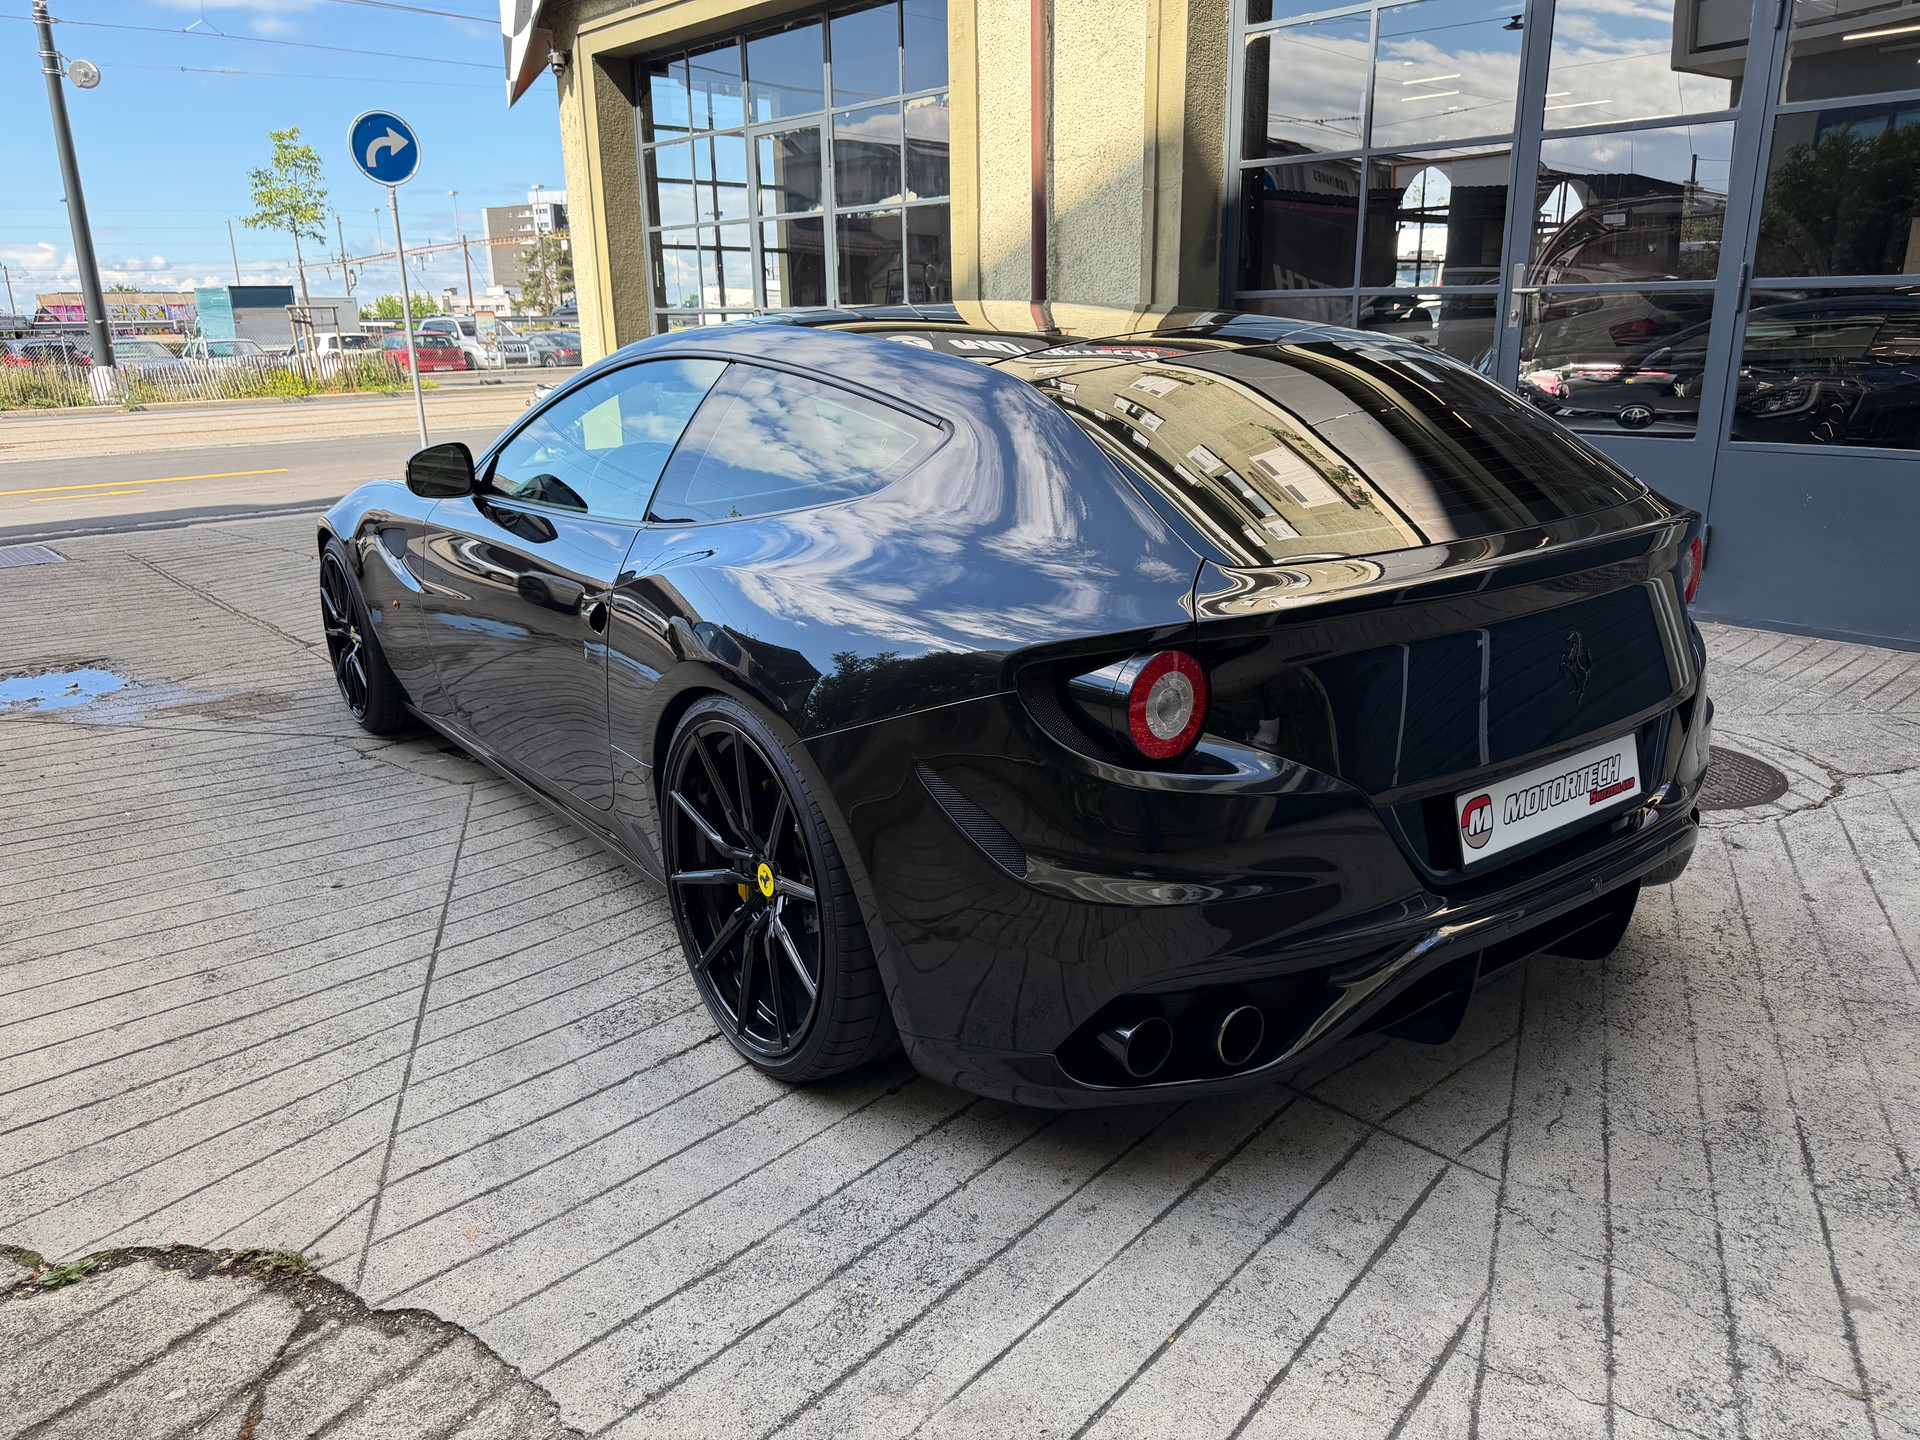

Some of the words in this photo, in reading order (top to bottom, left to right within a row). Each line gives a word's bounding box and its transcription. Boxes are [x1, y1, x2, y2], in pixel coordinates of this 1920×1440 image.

[1503, 753, 1621, 825] MOTORTECH
[1589, 777, 1636, 805] SWITZERLAND
[1468, 804, 1493, 837] M
